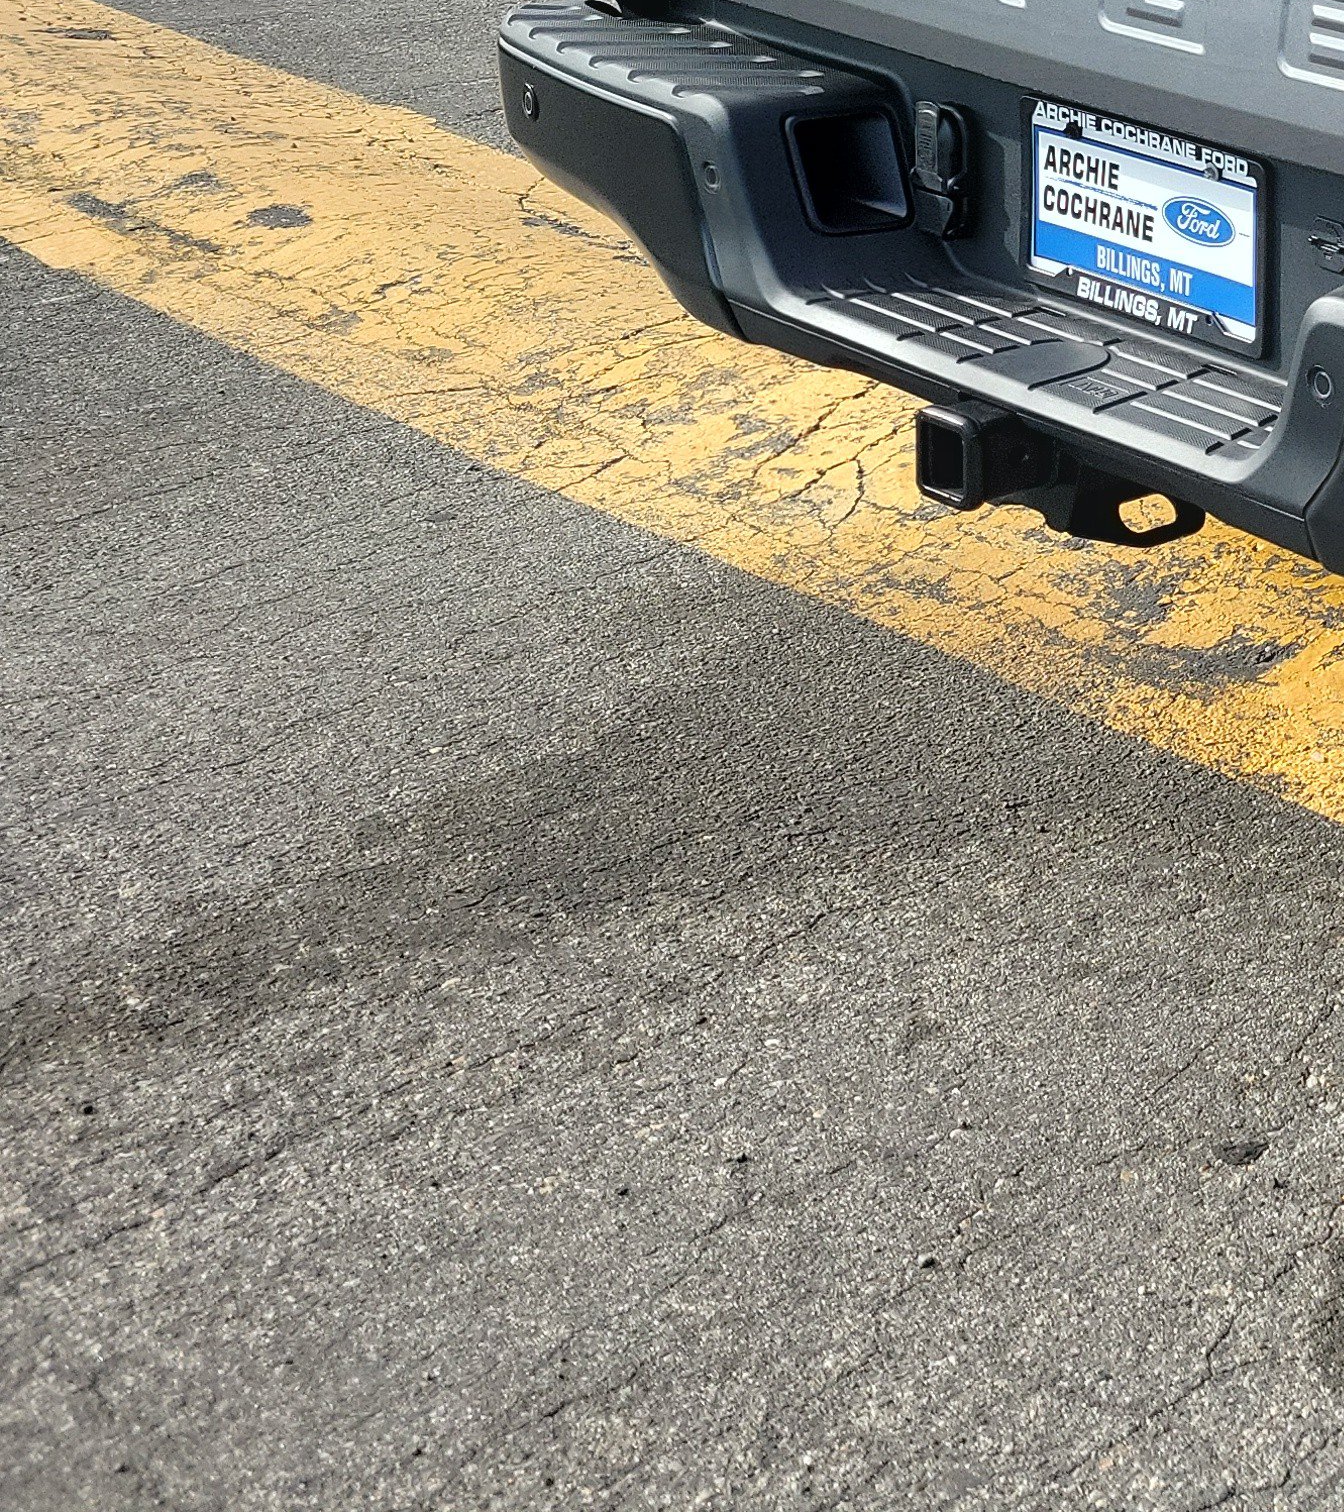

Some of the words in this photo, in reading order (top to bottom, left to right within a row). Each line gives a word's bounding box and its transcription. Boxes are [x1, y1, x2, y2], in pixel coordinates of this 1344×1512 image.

[1034, 101, 1097, 131] ARCHIE
[1100, 118, 1197, 162] COCHRANE
[1201, 148, 1249, 178] FORD
[1043, 144, 1121, 192] ARCHIE
[1043, 184, 1155, 243] COCHRANE
[1176, 202, 1221, 240] Ford
[1096, 244, 1166, 293] BILLINGS,
[1169, 268, 1194, 297] MT
[1076, 276, 1162, 326] BILLINGS,
[1167, 306, 1200, 334] MT
